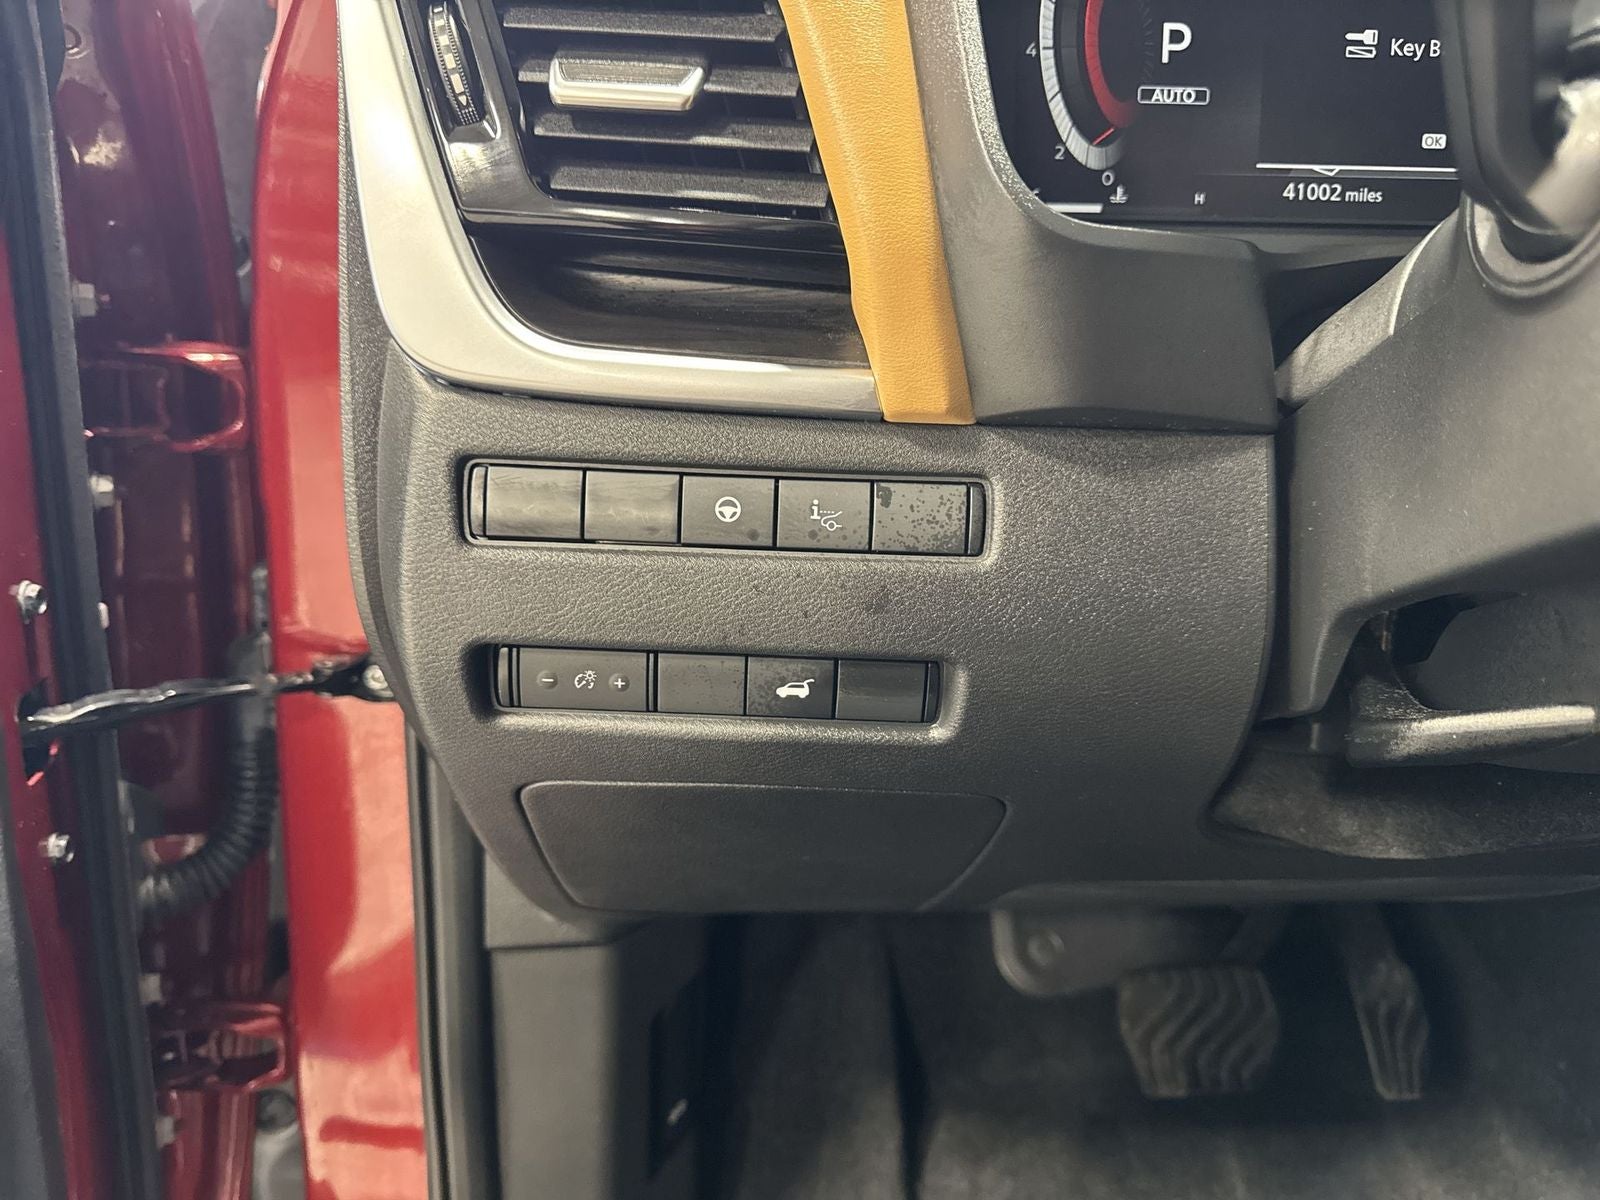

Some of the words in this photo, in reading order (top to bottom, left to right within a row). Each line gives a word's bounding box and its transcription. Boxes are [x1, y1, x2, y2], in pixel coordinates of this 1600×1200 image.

[1025, 41, 1037, 58] 4
[1161, 22, 1193, 64] P
[1390, 38, 1426, 61] Key
[1151, 88, 1197, 104] AUTO
[1423, 135, 1445, 148] OK
[1054, 145, 1065, 160] 2
[1194, 191, 1206, 205] H
[1282, 182, 1342, 201] 41002
[1345, 188, 1383, 203] miles
